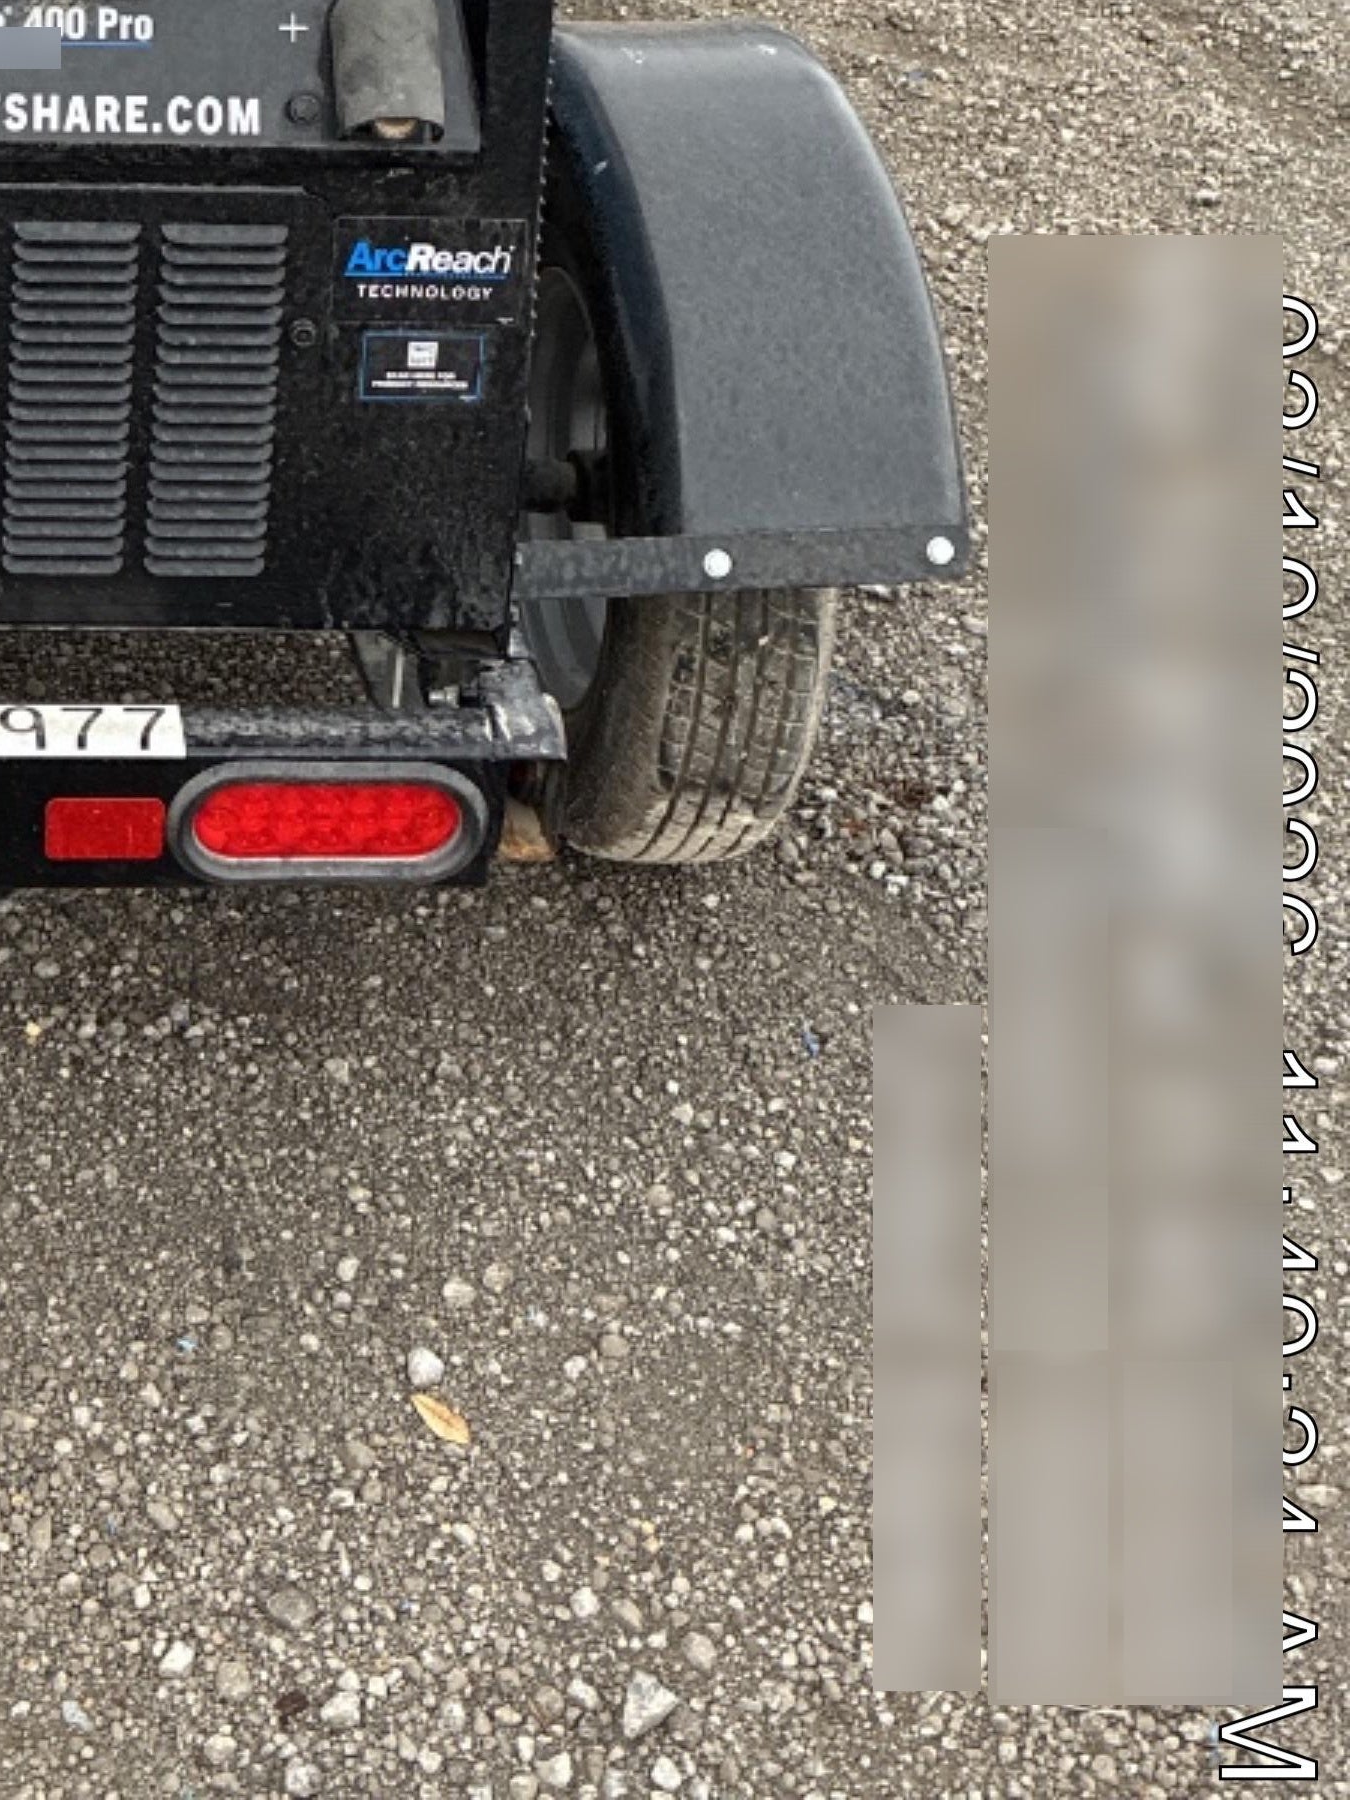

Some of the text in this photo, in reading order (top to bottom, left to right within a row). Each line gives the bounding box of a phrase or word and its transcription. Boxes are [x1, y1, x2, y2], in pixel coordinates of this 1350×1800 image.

[97, 6, 155, 41] Pro
[346, 240, 512, 275] ArcReach
[357, 284, 494, 300] TECHNOLOGY
